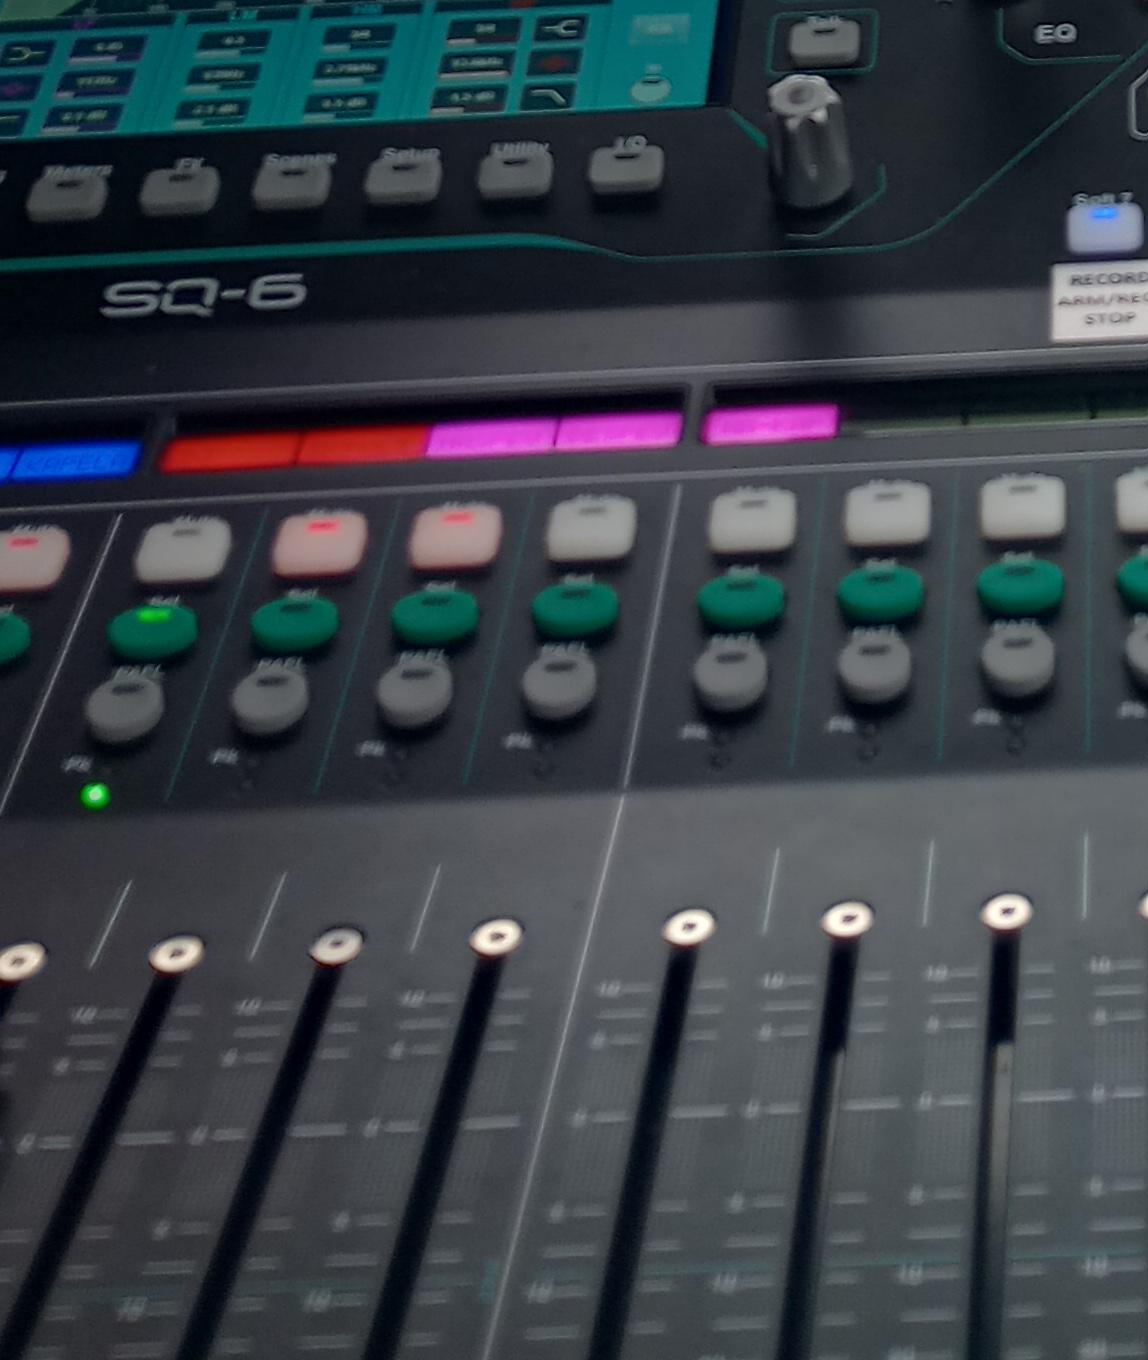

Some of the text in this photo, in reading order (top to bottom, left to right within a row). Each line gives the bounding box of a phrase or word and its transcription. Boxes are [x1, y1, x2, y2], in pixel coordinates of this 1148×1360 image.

[1034, 23, 1079, 45] EQ
[100, 273, 308, 318] SQ-6
[1084, 311, 1138, 327] STOP
